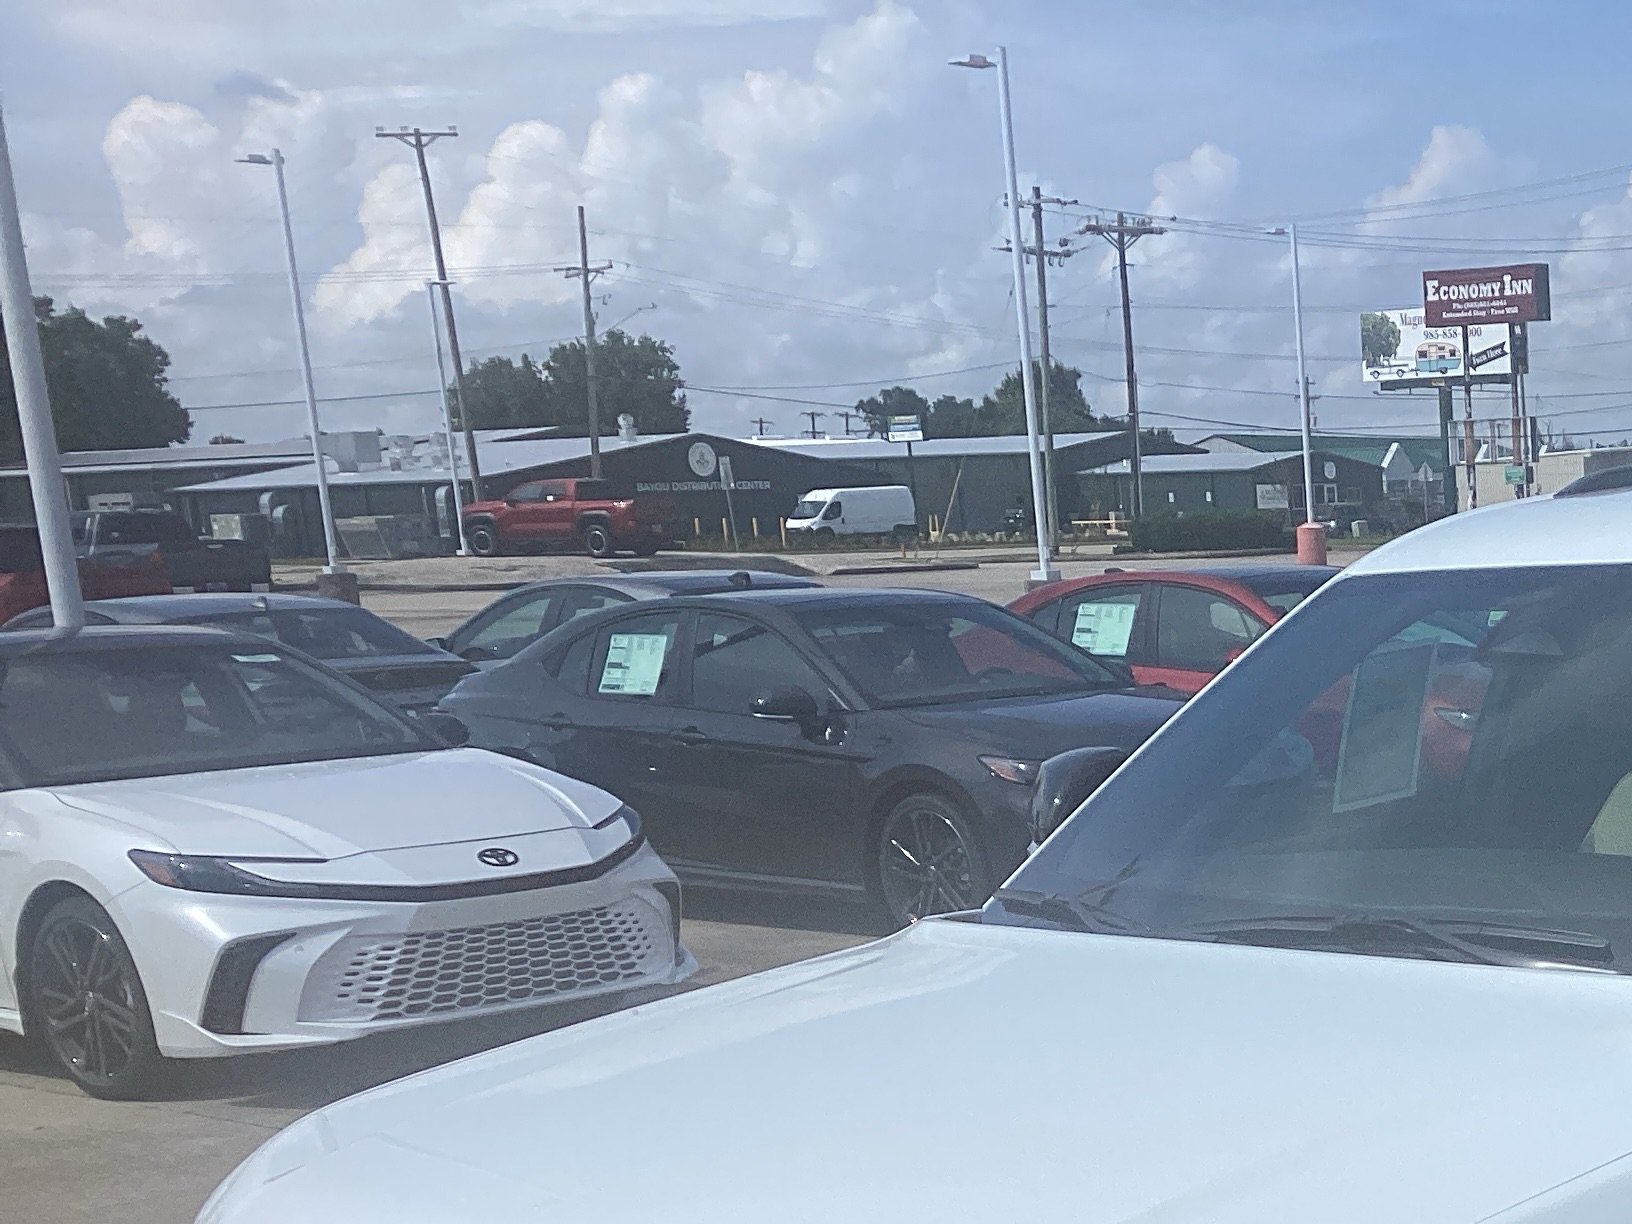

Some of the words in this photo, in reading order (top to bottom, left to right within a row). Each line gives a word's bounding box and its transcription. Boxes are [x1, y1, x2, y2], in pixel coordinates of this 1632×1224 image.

[1400, 312, 1426, 329] Magn
[637, 482, 669, 492] BAYOU
[736, 481, 771, 490] CENTER
